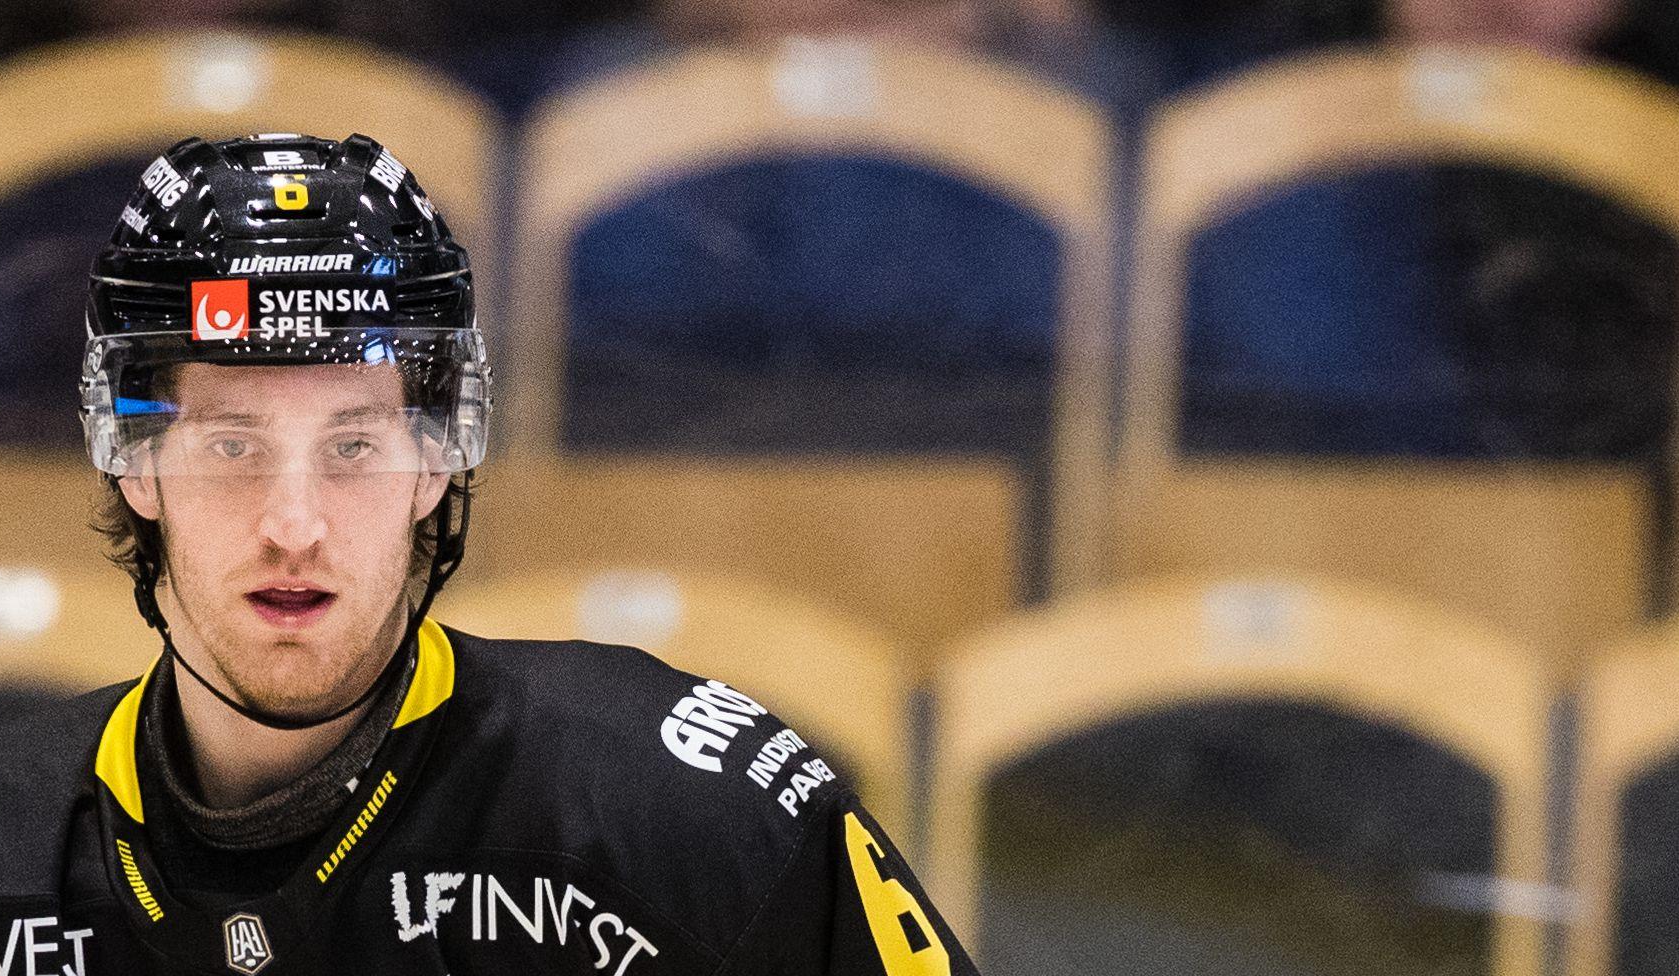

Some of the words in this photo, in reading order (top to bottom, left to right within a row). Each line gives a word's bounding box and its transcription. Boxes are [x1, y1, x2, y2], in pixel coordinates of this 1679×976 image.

[271, 173, 309, 211] 6
[229, 253, 354, 274] WARRIOR
[258, 289, 390, 314] SVENSKA
[259, 315, 331, 339] SPEL
[316, 770, 398, 884] WARRIOR
[116, 838, 164, 922] WARRIOR
